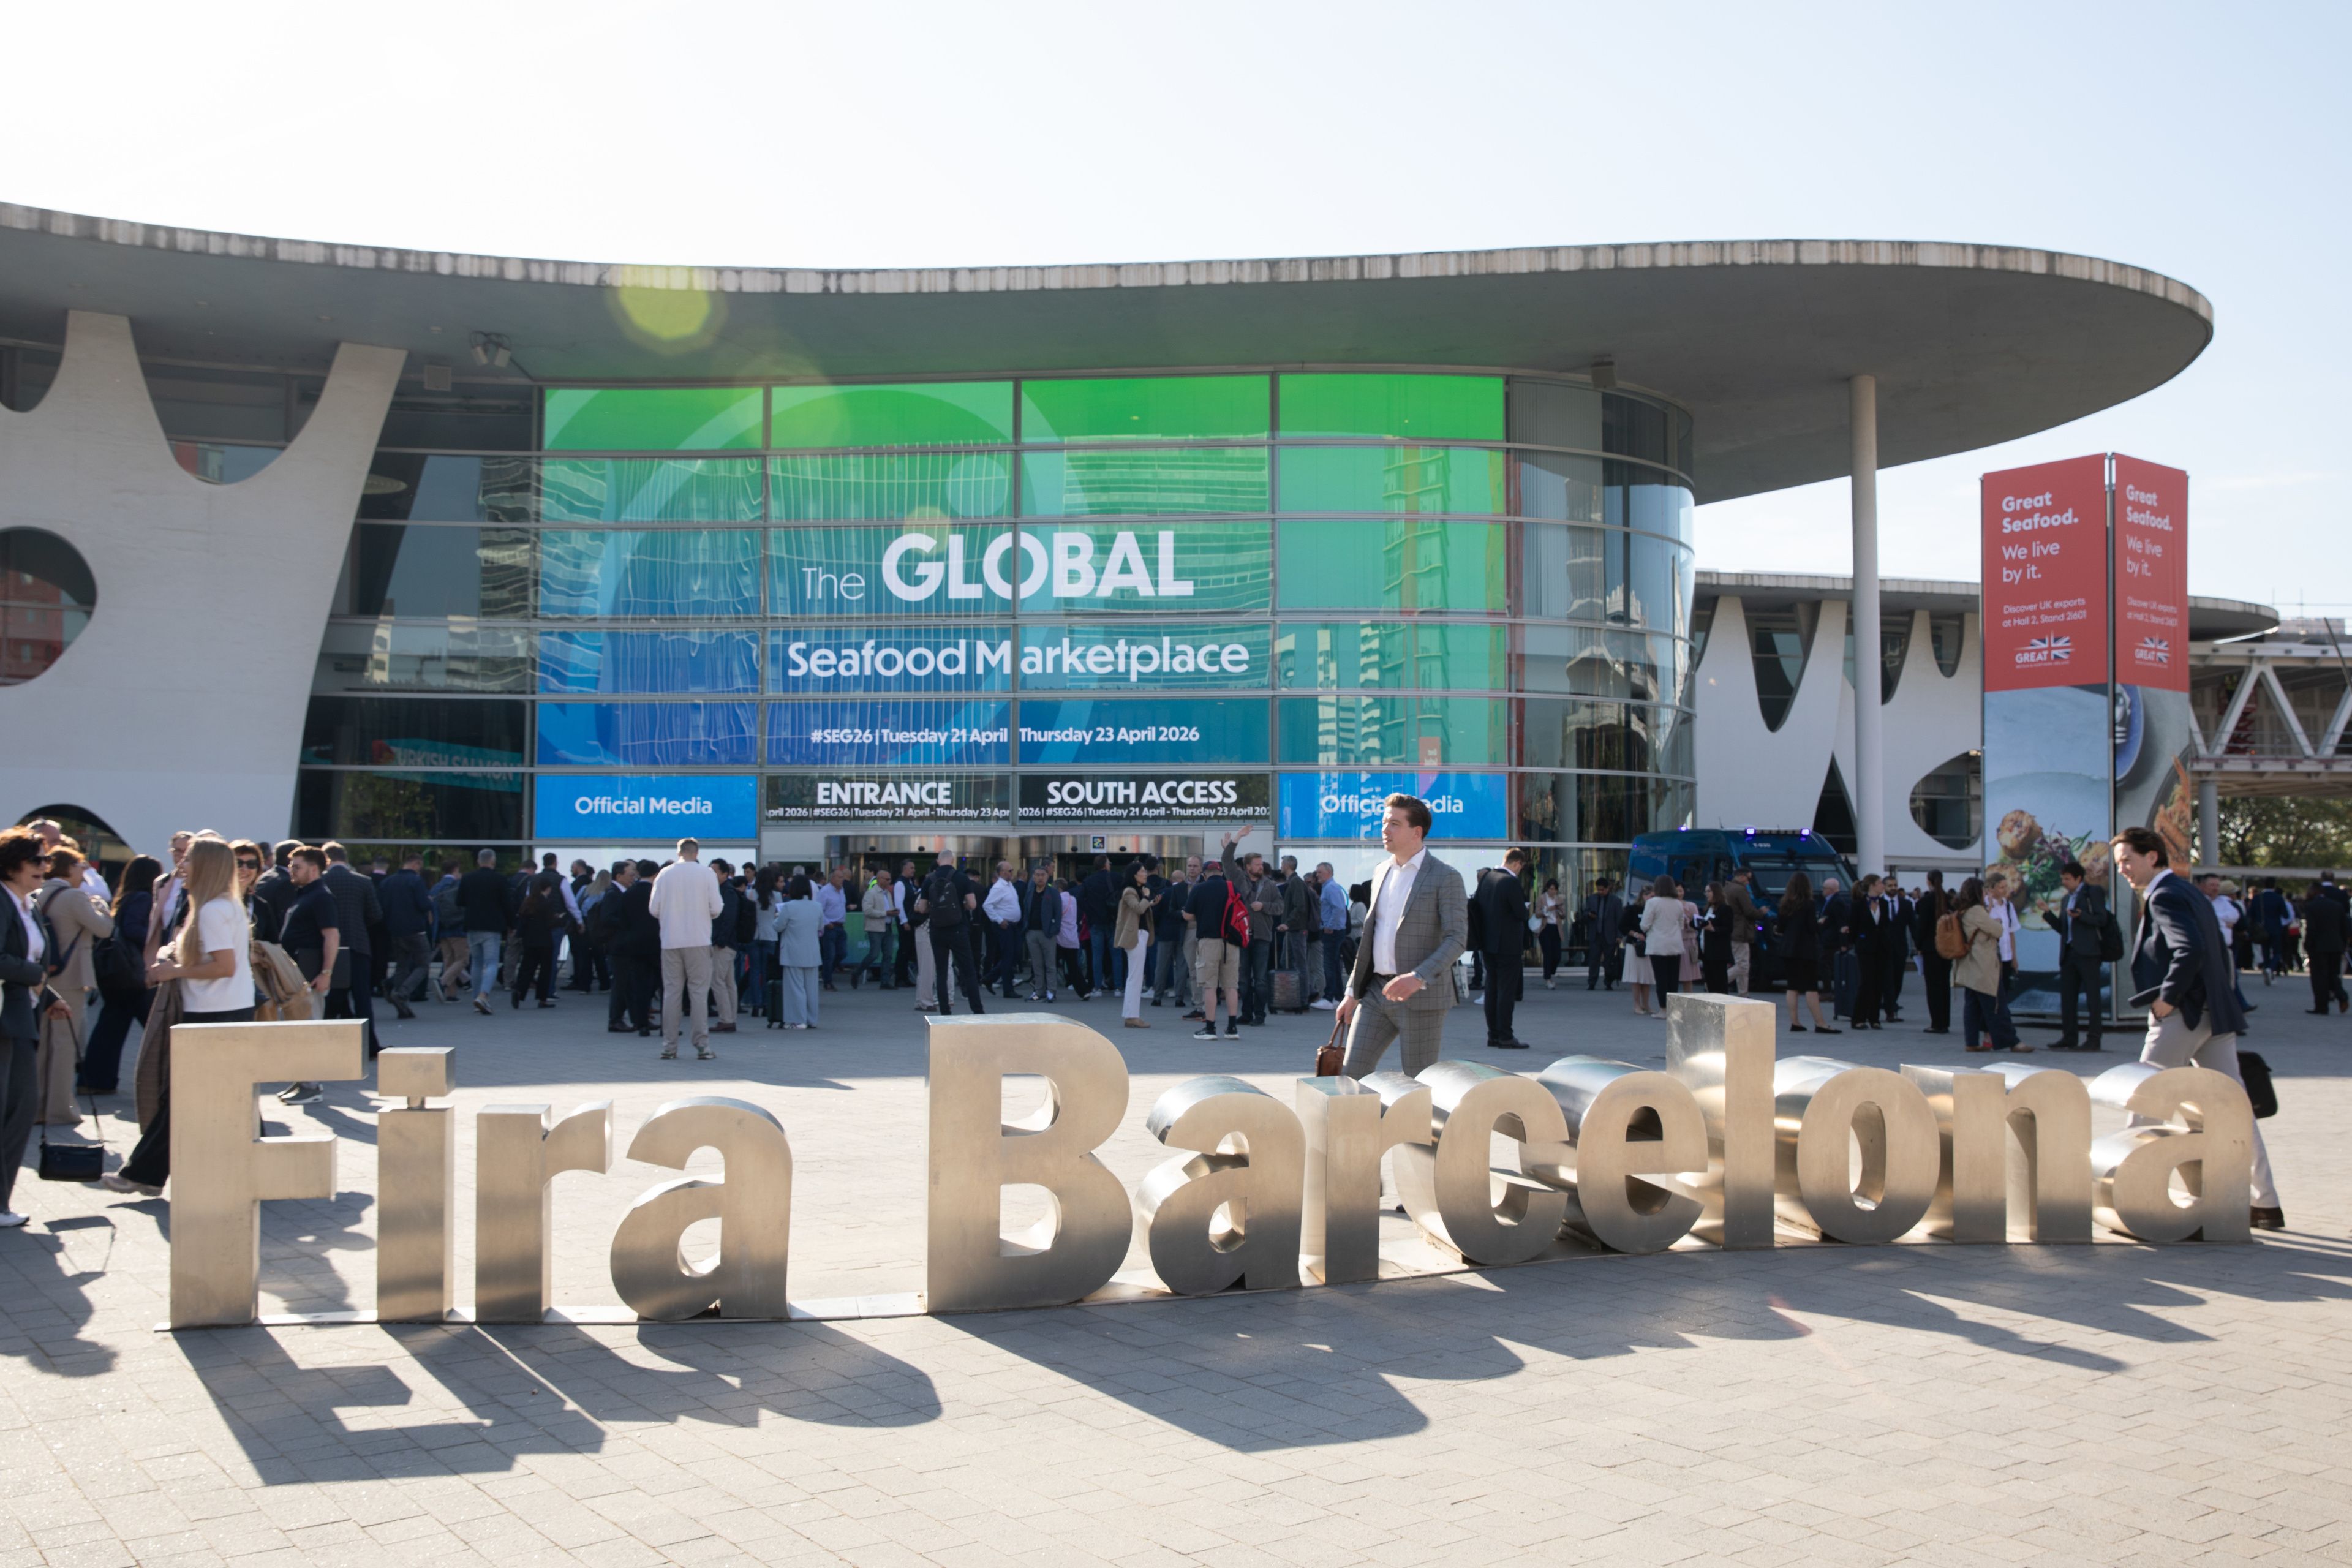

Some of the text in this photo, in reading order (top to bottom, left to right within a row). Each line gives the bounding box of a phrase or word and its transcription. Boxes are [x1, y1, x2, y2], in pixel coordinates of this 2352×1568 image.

[2002, 491, 2052, 513] Great
[2125, 484, 2157, 507] Great
[2002, 507, 2079, 534] Seafood.
[2126, 505, 2173, 532] Seafood.
[2002, 540, 2060, 560] We live
[2126, 534, 2163, 557] We live
[802, 530, 1195, 602] The GLOBAL
[2002, 563, 2041, 585] by it.
[2126, 556, 2152, 578] by it.
[2003, 597, 2086, 614] Discover UK exports
[2002, 619, 2012, 628] at
[2013, 616, 2030, 627] Hall
[2040, 612, 2064, 624] Stand
[788, 636, 1251, 682] Seafood Marketplace
[2015, 650, 2049, 664] GREAT
[810, 728, 873, 744] #SEG26
[881, 728, 948, 746] Tuesday
[951, 728, 967, 743] 21
[969, 728, 1008, 746] April
[1019, 726, 1093, 745] Thursday
[1095, 726, 1115, 742] 23
[1116, 726, 1156, 745] April
[1158, 726, 1200, 742] 2026
[816, 781, 952, 805] ENTRANCE
[1047, 780, 1238, 805] SOUTH ACCESS
[574, 796, 713, 815] Official Media
[785, 807, 809, 817] 2026
[813, 807, 850, 817] #SEG26
[854, 807, 894, 818] Tuesday
[895, 807, 905, 817] 21
[907, 807, 930, 818] April
[936, 807, 979, 818] Thursday
[980, 807, 992, 817] 23
[1018, 807, 1041, 817] 2026
[1045, 807, 1084, 817] #SEG26
[1087, 807, 1129, 818] Tuesday
[1129, 806, 1140, 816] 21
[1141, 806, 1166, 818] April
[1171, 806, 1216, 818] Thursday
[1216, 806, 1229, 816] 23
[1229, 805, 1253, 818] April
[170, 992, 2254, 1327] Fira Barcelona
